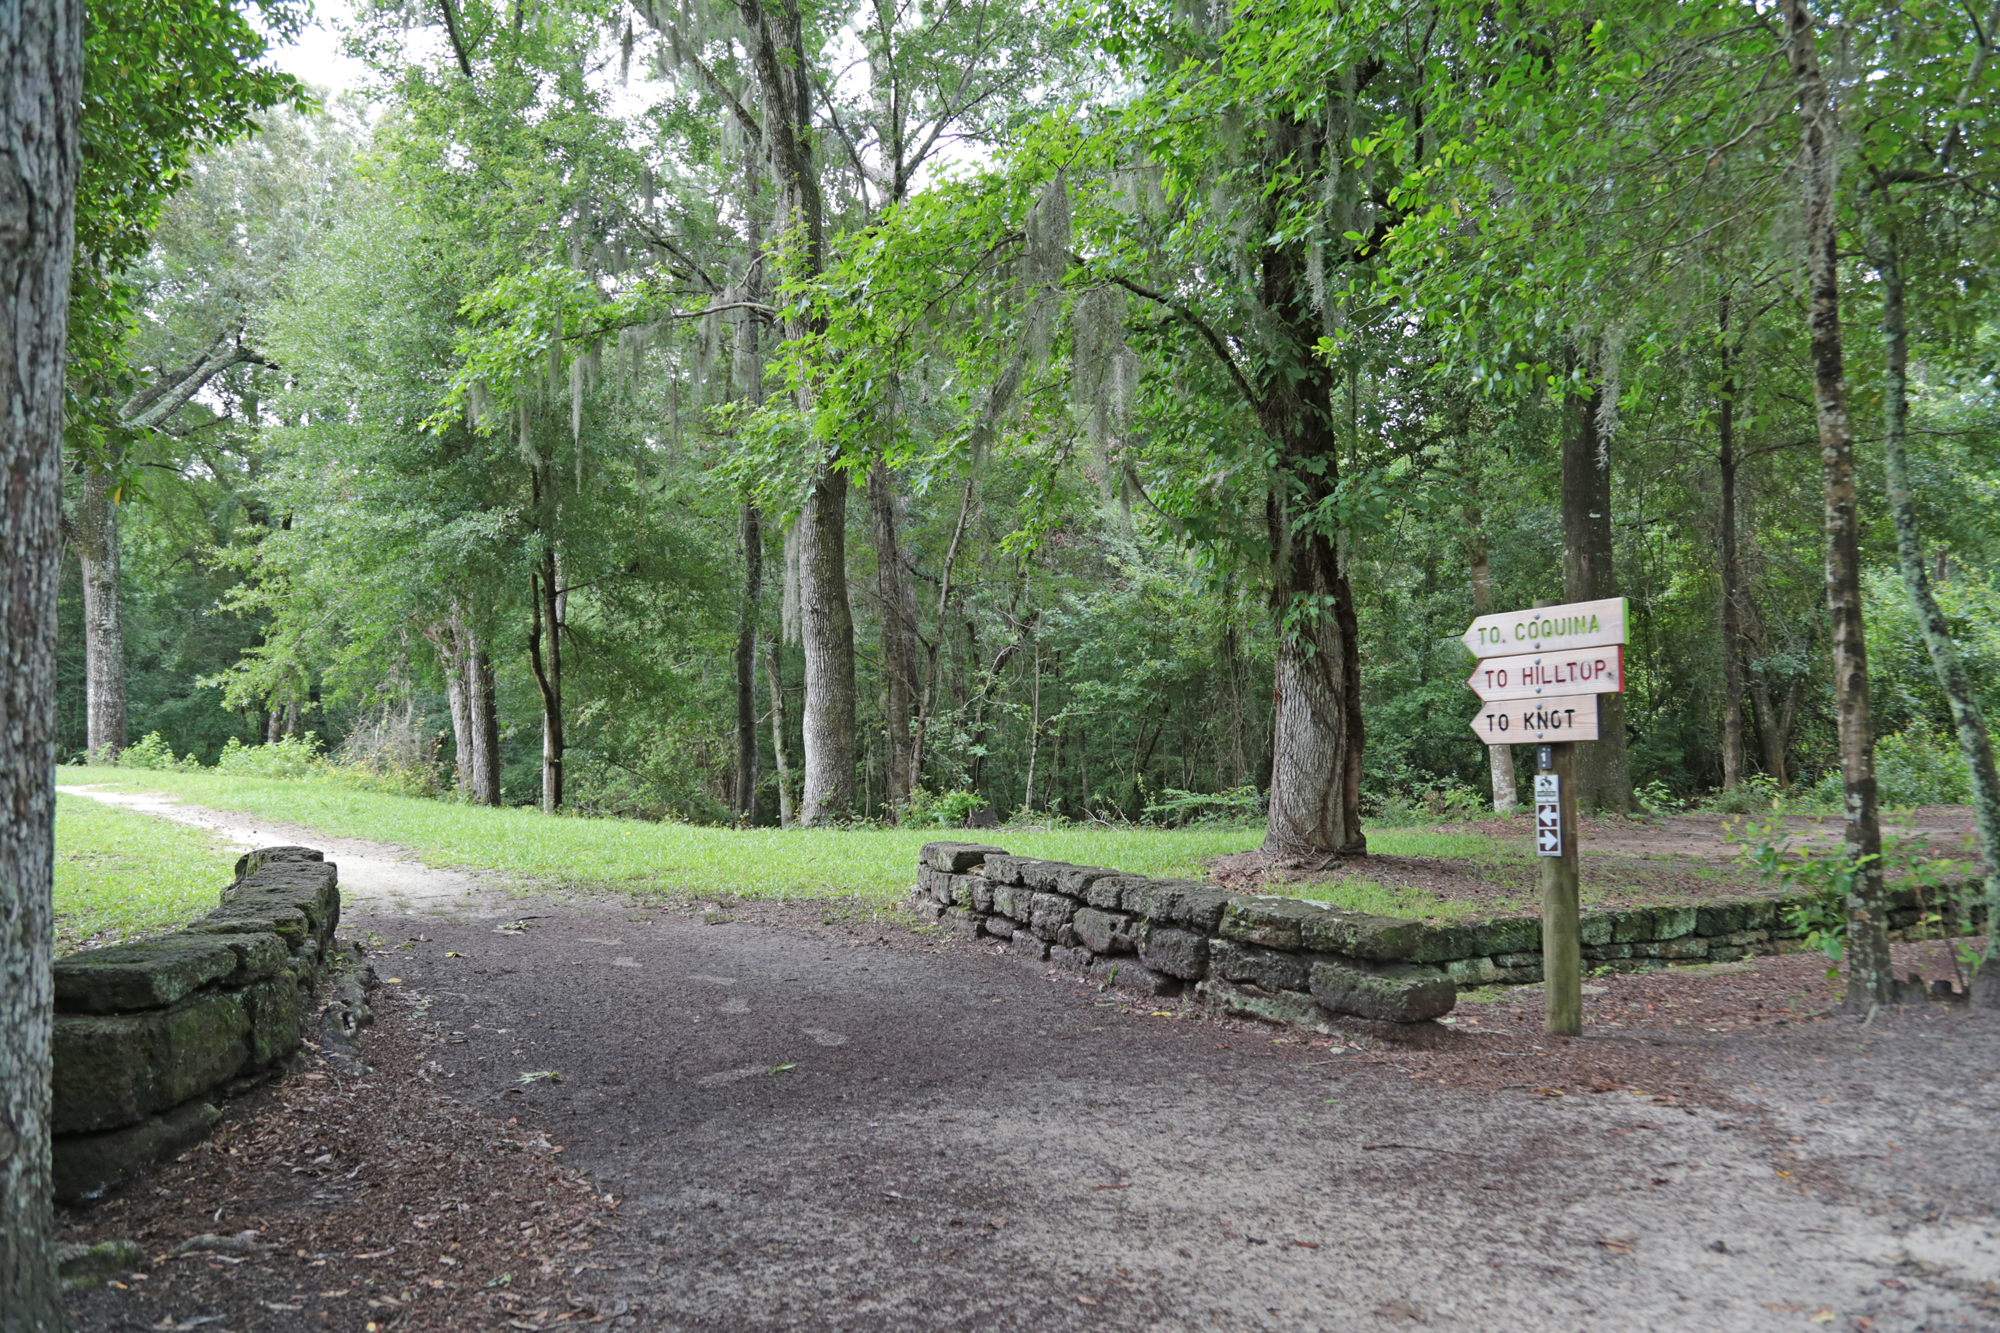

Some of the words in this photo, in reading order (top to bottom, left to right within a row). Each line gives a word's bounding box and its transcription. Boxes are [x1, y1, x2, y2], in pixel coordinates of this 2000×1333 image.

[1515, 614, 1600, 641] COQUINA
[1485, 669, 1507, 689] TO
[1522, 660, 1606, 686] HILLTOP
[1486, 713, 1509, 732] TO
[1524, 709, 1575, 730] KNOT
[1540, 752, 1547, 762] 1
